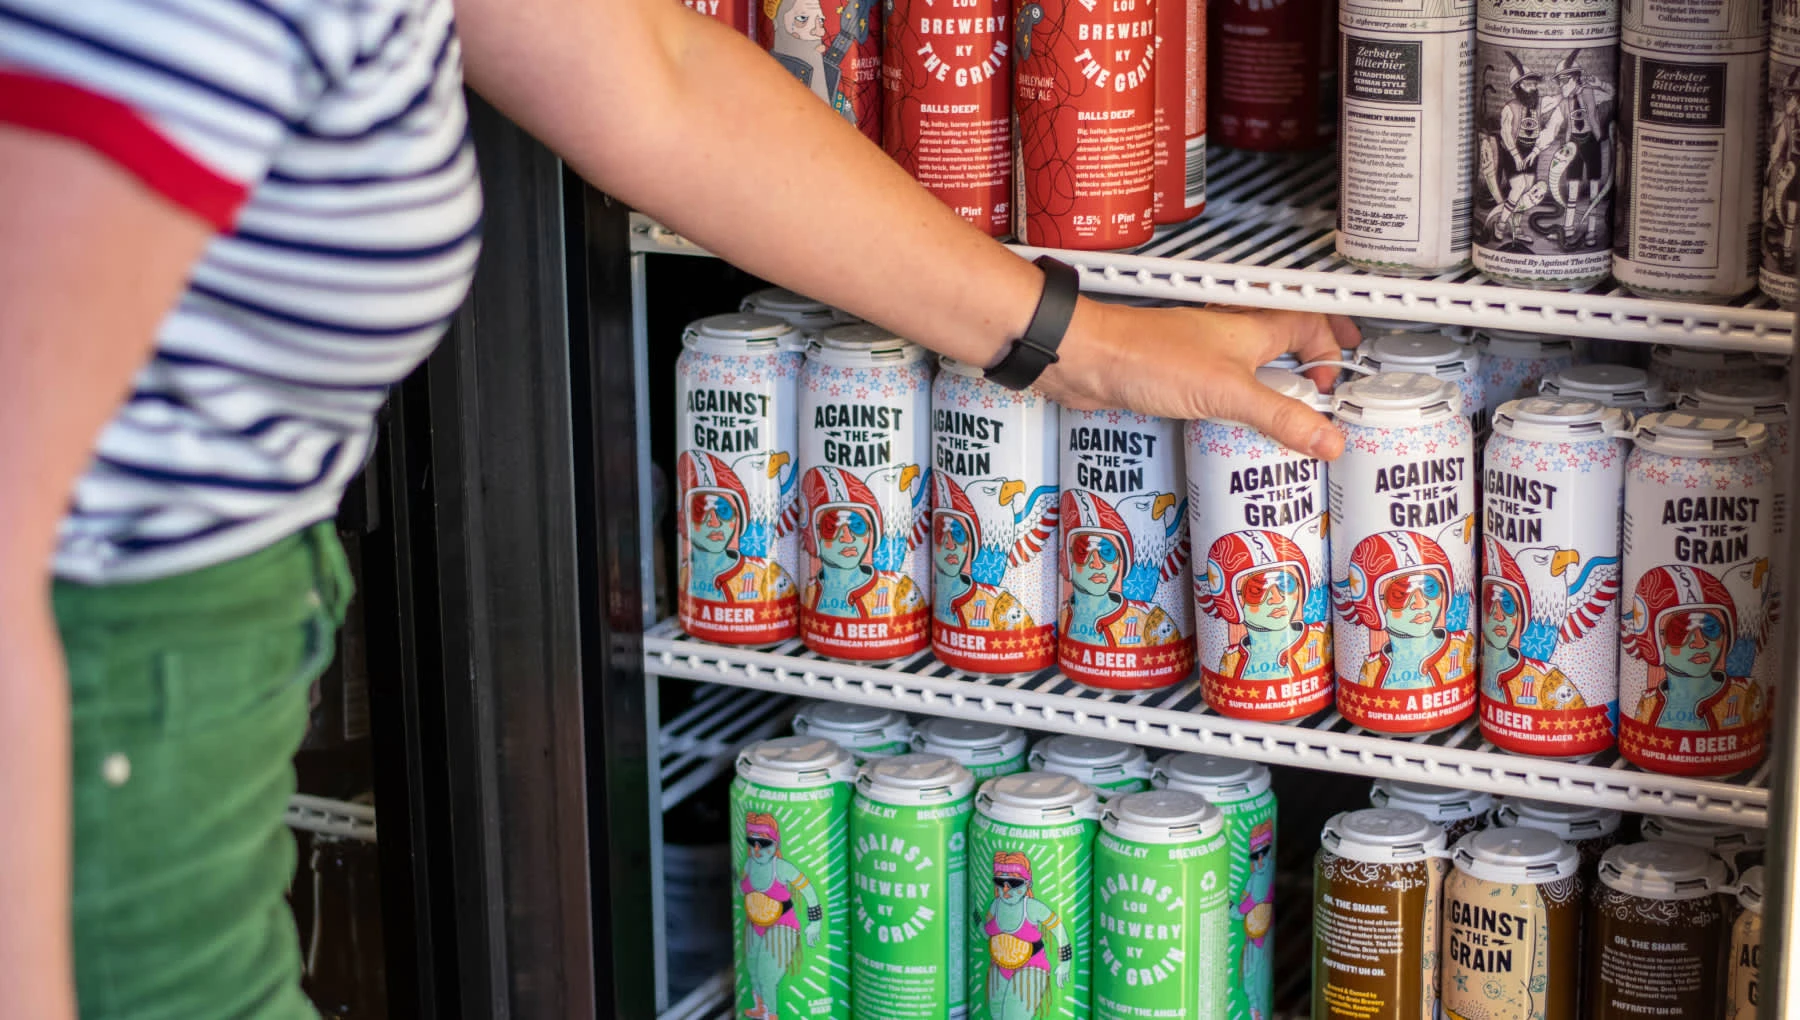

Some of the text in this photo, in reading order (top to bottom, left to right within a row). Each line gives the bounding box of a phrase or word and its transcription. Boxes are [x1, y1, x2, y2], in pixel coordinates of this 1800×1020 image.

[1113, 0, 1136, 12] LOU
[1510, 10, 1548, 18] PROJECT
[1564, 10, 1606, 18] TRADITION
[920, 16, 1006, 35] BREWERY
[1079, 20, 1153, 41] BREWERY
[955, 45, 973, 57] KY
[1115, 50, 1131, 62] KY
[1358, 46, 1403, 60] Zerbster
[916, 42, 951, 82] THE
[955, 40, 1009, 87] GRAIN
[1074, 45, 1154, 92] THE GRAIN
[1355, 57, 1406, 70] Bitterbier
[1354, 77, 1380, 87] GERMAN
[1360, 71, 1406, 81] TRADITIONAL
[1655, 69, 1706, 82] Zerbster
[1356, 86, 1382, 94] SMOKED
[1652, 80, 1710, 93] Bitterbier
[1657, 94, 1708, 103] TRADITIONAL
[920, 104, 980, 114] BALLS DEEP!
[1078, 112, 1109, 121] BALLS
[961, 206, 982, 217] Pint
[1073, 213, 1135, 225] 12.5% Pint
[687, 389, 771, 417] AGAINST
[712, 415, 736, 428] THE
[815, 404, 903, 431] AGAINST
[694, 423, 759, 453] GRAIN
[844, 431, 869, 442] THE
[949, 436, 969, 451] THE
[1070, 427, 1157, 458] AGAINST
[824, 439, 890, 467] GRAIN
[937, 443, 991, 477] GRAIN
[1095, 455, 1120, 467] THE
[1077, 462, 1143, 493] GRAIN
[1230, 458, 1319, 494] AGAINST
[1375, 457, 1464, 494] AGAINST
[1266, 487, 1293, 502] THE
[1413, 487, 1439, 501] THE
[1244, 492, 1313, 527] GRAIN
[1390, 492, 1458, 528] GRAIN
[1499, 499, 1519, 515] THE
[1662, 497, 1760, 524] AGAINST
[1488, 507, 1542, 543] GRAIN
[1700, 524, 1728, 537] THE
[1675, 534, 1748, 565] GRAIN
[702, 605, 755, 623] A BEER
[731, 624, 767, 632] PREMIUM
[834, 622, 889, 639] A BEER
[865, 638, 900, 648] PREMIUM
[942, 629, 986, 652] A BEER
[963, 650, 1024, 661] PREMIUM LAGER
[1082, 649, 1137, 668] A BEER
[1075, 664, 1110, 677] AMERICAN
[1111, 669, 1149, 678] PREMIUM
[1150, 666, 1173, 676] LAGER
[1266, 676, 1319, 700] A BEER
[1229, 699, 1298, 710] SUPER AMERICAN
[1406, 687, 1461, 711] A BEER
[1368, 700, 1469, 721] SUPER AMERICAN PREMIUM
[1487, 704, 1533, 731] A BEER
[1510, 730, 1546, 742] PREMIUM
[1547, 733, 1573, 742] LAGER
[1680, 735, 1736, 753] A BEER
[1641, 749, 1667, 760] SUPER
[1668, 755, 1712, 764] AMERICAN
[760, 789, 834, 802] GRAIN BREWERY
[884, 808, 897, 818] KY
[992, 823, 1085, 840] THE GRAIN BREWERY
[855, 833, 934, 870] AGAINST
[1134, 845, 1209, 860] KY BREWER
[874, 859, 897, 873] LOU
[1100, 873, 1184, 912] AGAINST
[878, 904, 895, 917] KY
[1123, 900, 1148, 914] LOU
[1335, 898, 1388, 915] THE SHAME.
[878, 905, 936, 944] GRAIN
[1100, 912, 1181, 940] BREWERY
[1465, 930, 1488, 946] THE
[1615, 935, 1630, 948] OH,
[1631, 939, 1650, 950] THE
[1126, 946, 1144, 959] KY
[1450, 934, 1512, 973] GRAIN
[1099, 935, 1186, 986] THE GRAIN
[904, 966, 937, 975] ANGLE!
[1358, 967, 1386, 977] UH OH.
[1133, 1007, 1152, 1017] THE
[1153, 1008, 1187, 1017] ANGLE!
[1656, 1007, 1669, 1015] UH
